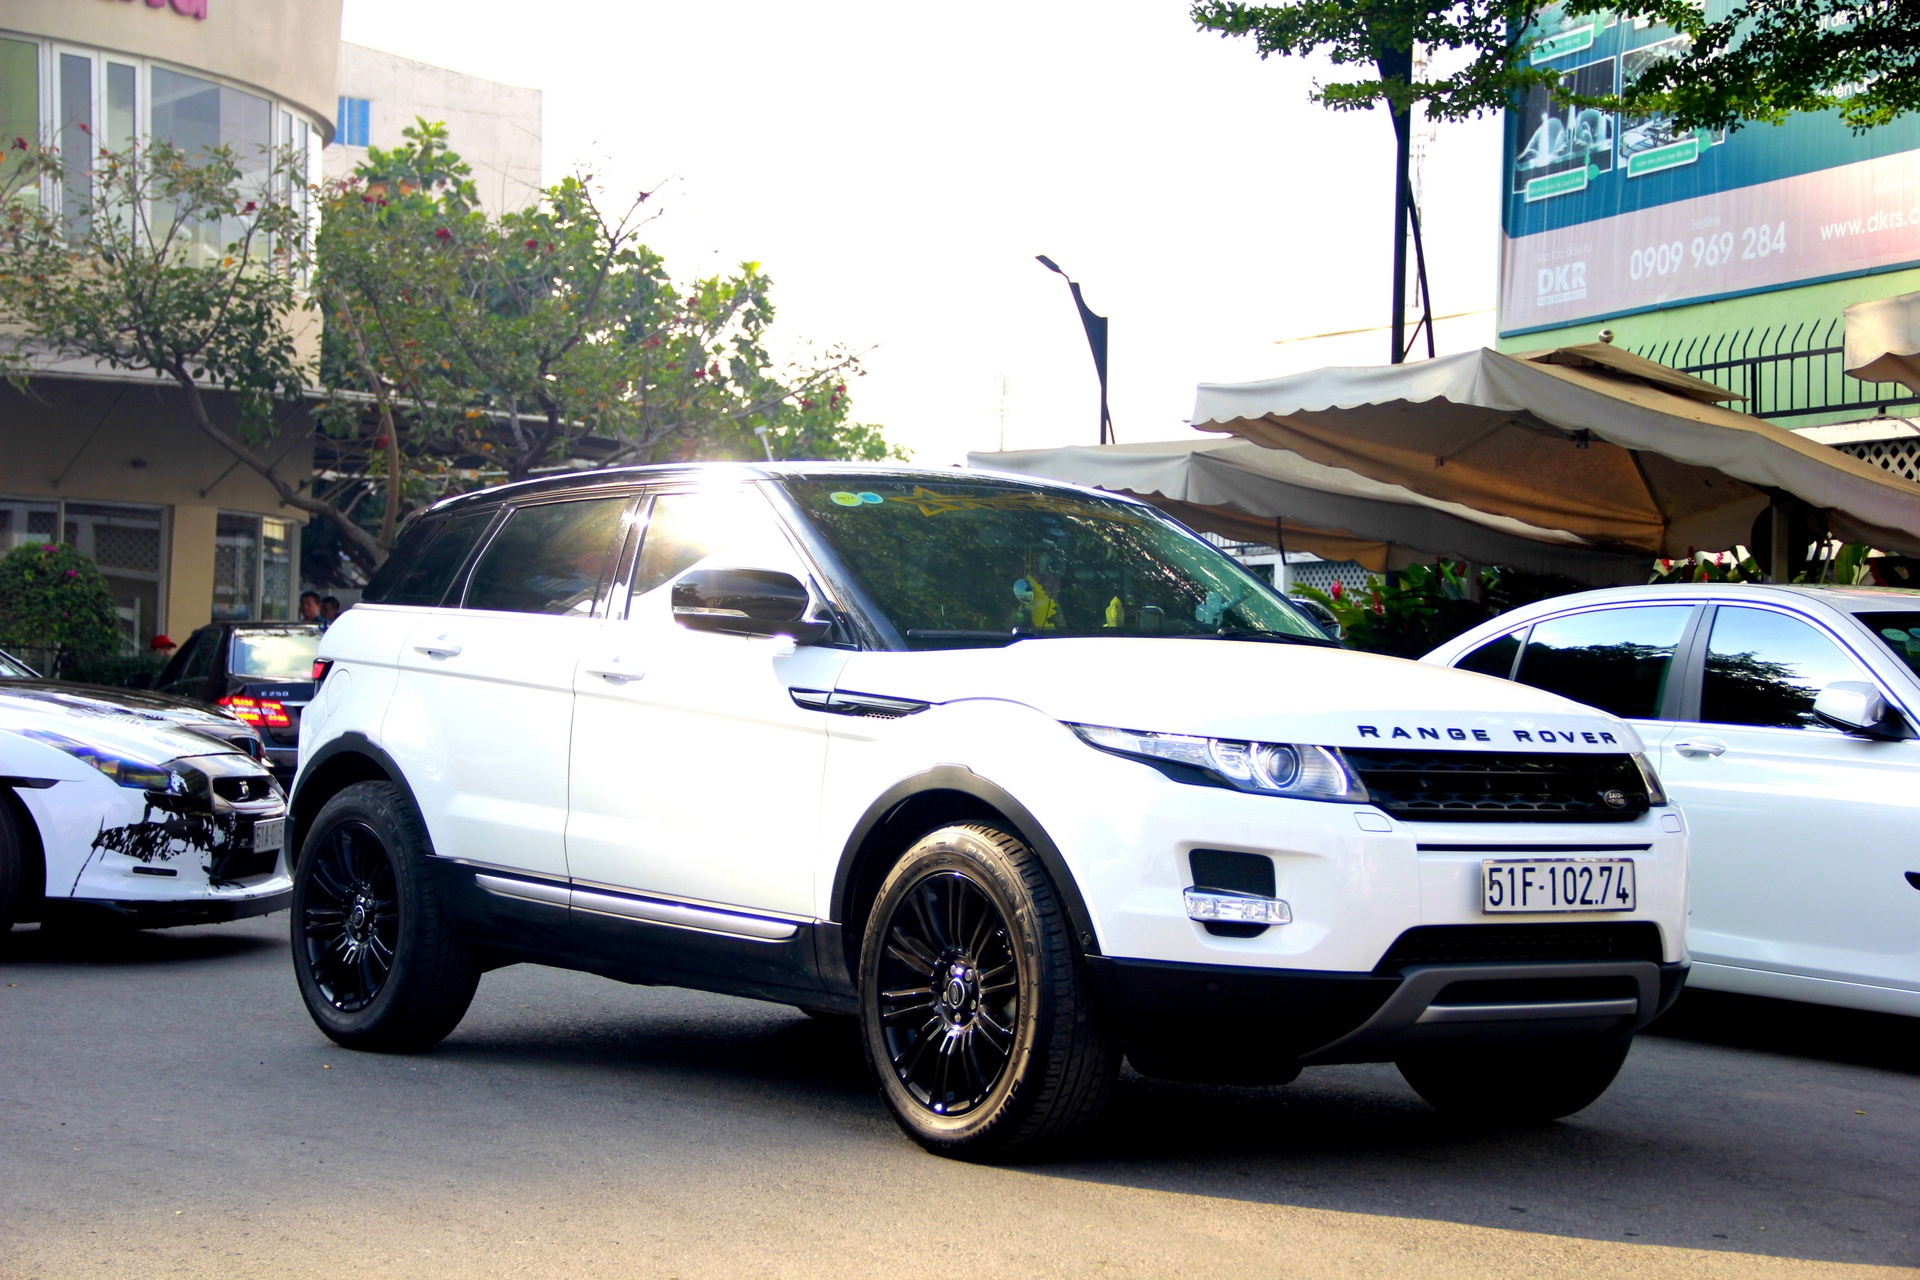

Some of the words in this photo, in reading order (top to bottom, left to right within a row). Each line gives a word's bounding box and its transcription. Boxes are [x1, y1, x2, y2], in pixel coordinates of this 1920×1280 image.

[1630, 241, 1684, 281] 0909
[1691, 231, 1734, 269] 969
[1741, 220, 1787, 261] 284
[1537, 261, 1587, 295] DKR
[1357, 725, 1491, 742] RANGE
[1512, 729, 1618, 744] ROVER
[1488, 866, 1629, 906] 51F-102.74
